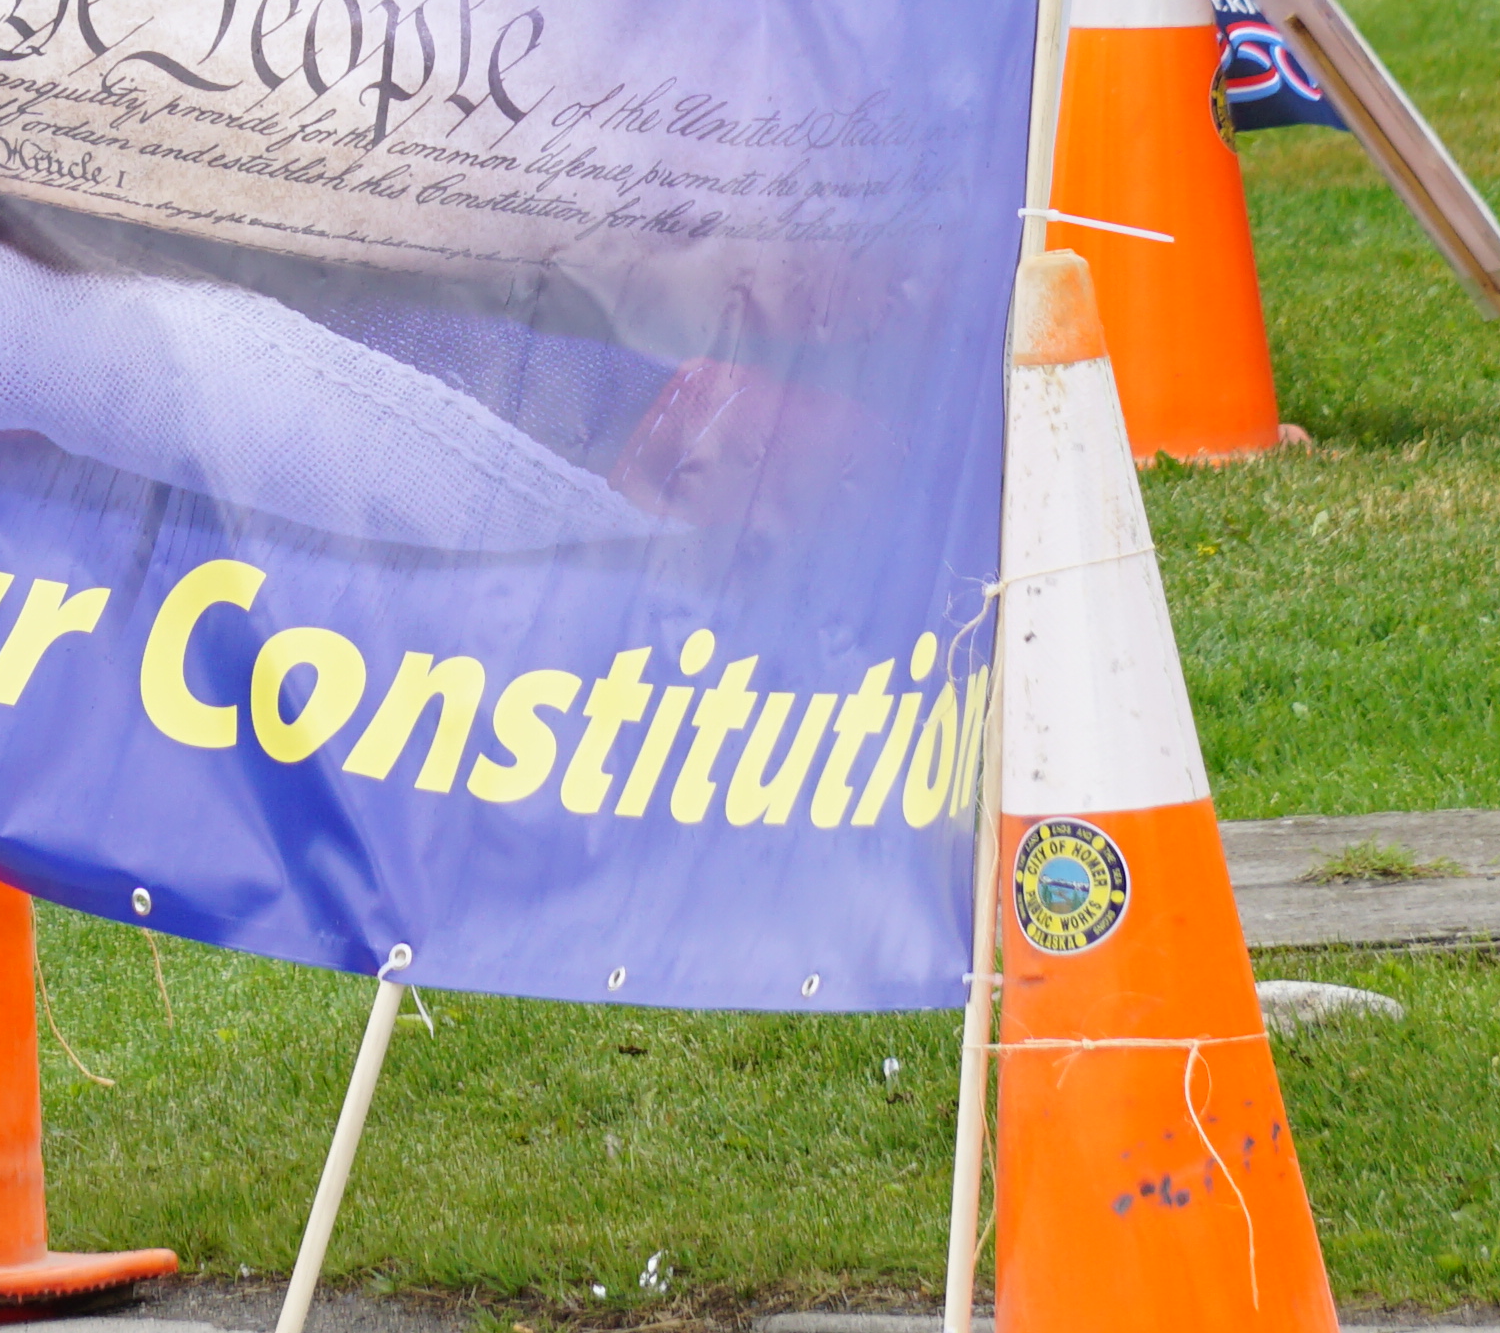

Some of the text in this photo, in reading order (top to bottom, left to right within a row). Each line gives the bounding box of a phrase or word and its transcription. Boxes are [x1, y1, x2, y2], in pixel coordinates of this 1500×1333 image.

[600, 76, 677, 134] the
[139, 143, 219, 165] and
[207, 155, 363, 191] establish
[139, 558, 989, 830] Constitution
[1027, 839, 1108, 887] CITY OF HOMER
[1025, 890, 1103, 932] PUBLIC WORKS
[1032, 927, 1077, 951] ALASKA
